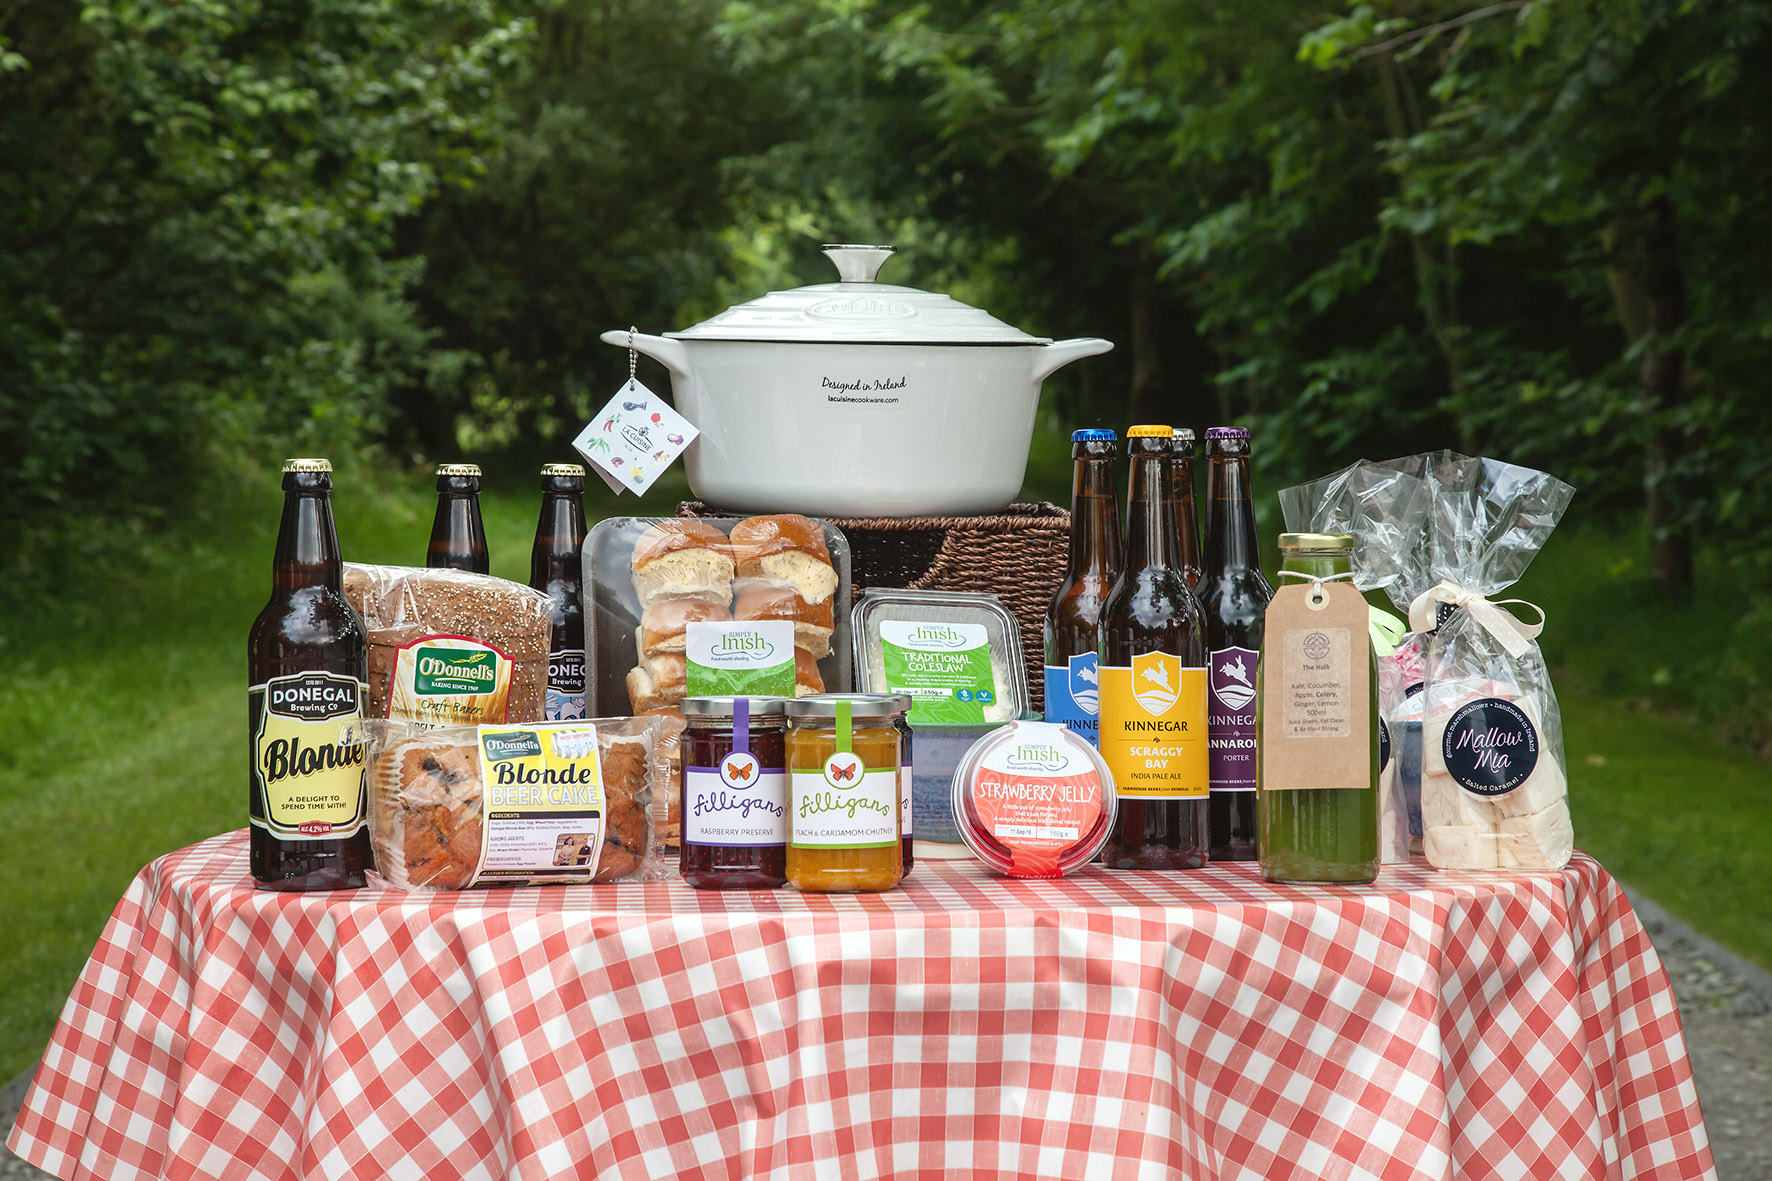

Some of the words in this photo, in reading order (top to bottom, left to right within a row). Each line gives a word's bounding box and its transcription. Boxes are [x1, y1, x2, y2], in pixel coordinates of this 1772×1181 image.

[822, 376, 860, 394] Designed
[874, 376, 906, 391] Ireland
[828, 395, 898, 404] lacuisinecookware.com
[622, 426, 630, 434] LA
[630, 432, 652, 452] CUISINE
[722, 632, 766, 650] Inish
[917, 626, 958, 640] Inish
[901, 652, 973, 664] TRADITIONAL
[420, 657, 494, 681] O'Donnell's
[908, 662, 964, 673] COLESLAW
[552, 678, 582, 687] Brewing
[273, 688, 354, 705] DONEGAL
[291, 704, 326, 713] Brewing
[421, 700, 450, 712] Craft
[453, 702, 484, 715] Bakers
[1124, 721, 1188, 732] KINNEGAR
[1450, 703, 1488, 732] marshmallows
[1494, 702, 1523, 722] handmade
[1526, 727, 1536, 752] Ireland
[486, 739, 539, 751] O'Donnell's
[1456, 727, 1524, 753] Mallow
[264, 727, 364, 783] Blonde
[1016, 745, 1060, 762] Inish
[1130, 747, 1183, 756] SCRAGGY
[1145, 759, 1168, 769] BAY
[1474, 750, 1512, 774] Mia
[493, 762, 591, 785] Blonde
[980, 782, 1056, 801] STRAWBERRY
[1058, 786, 1096, 803] JELLY
[1465, 779, 1487, 791] Salted
[1490, 777, 1519, 791] Caramel
[491, 786, 543, 806] BEER
[548, 786, 598, 805] CAKE
[694, 792, 784, 818] filligans
[800, 792, 890, 818] filligans
[865, 828, 893, 836] CHUTNEY
